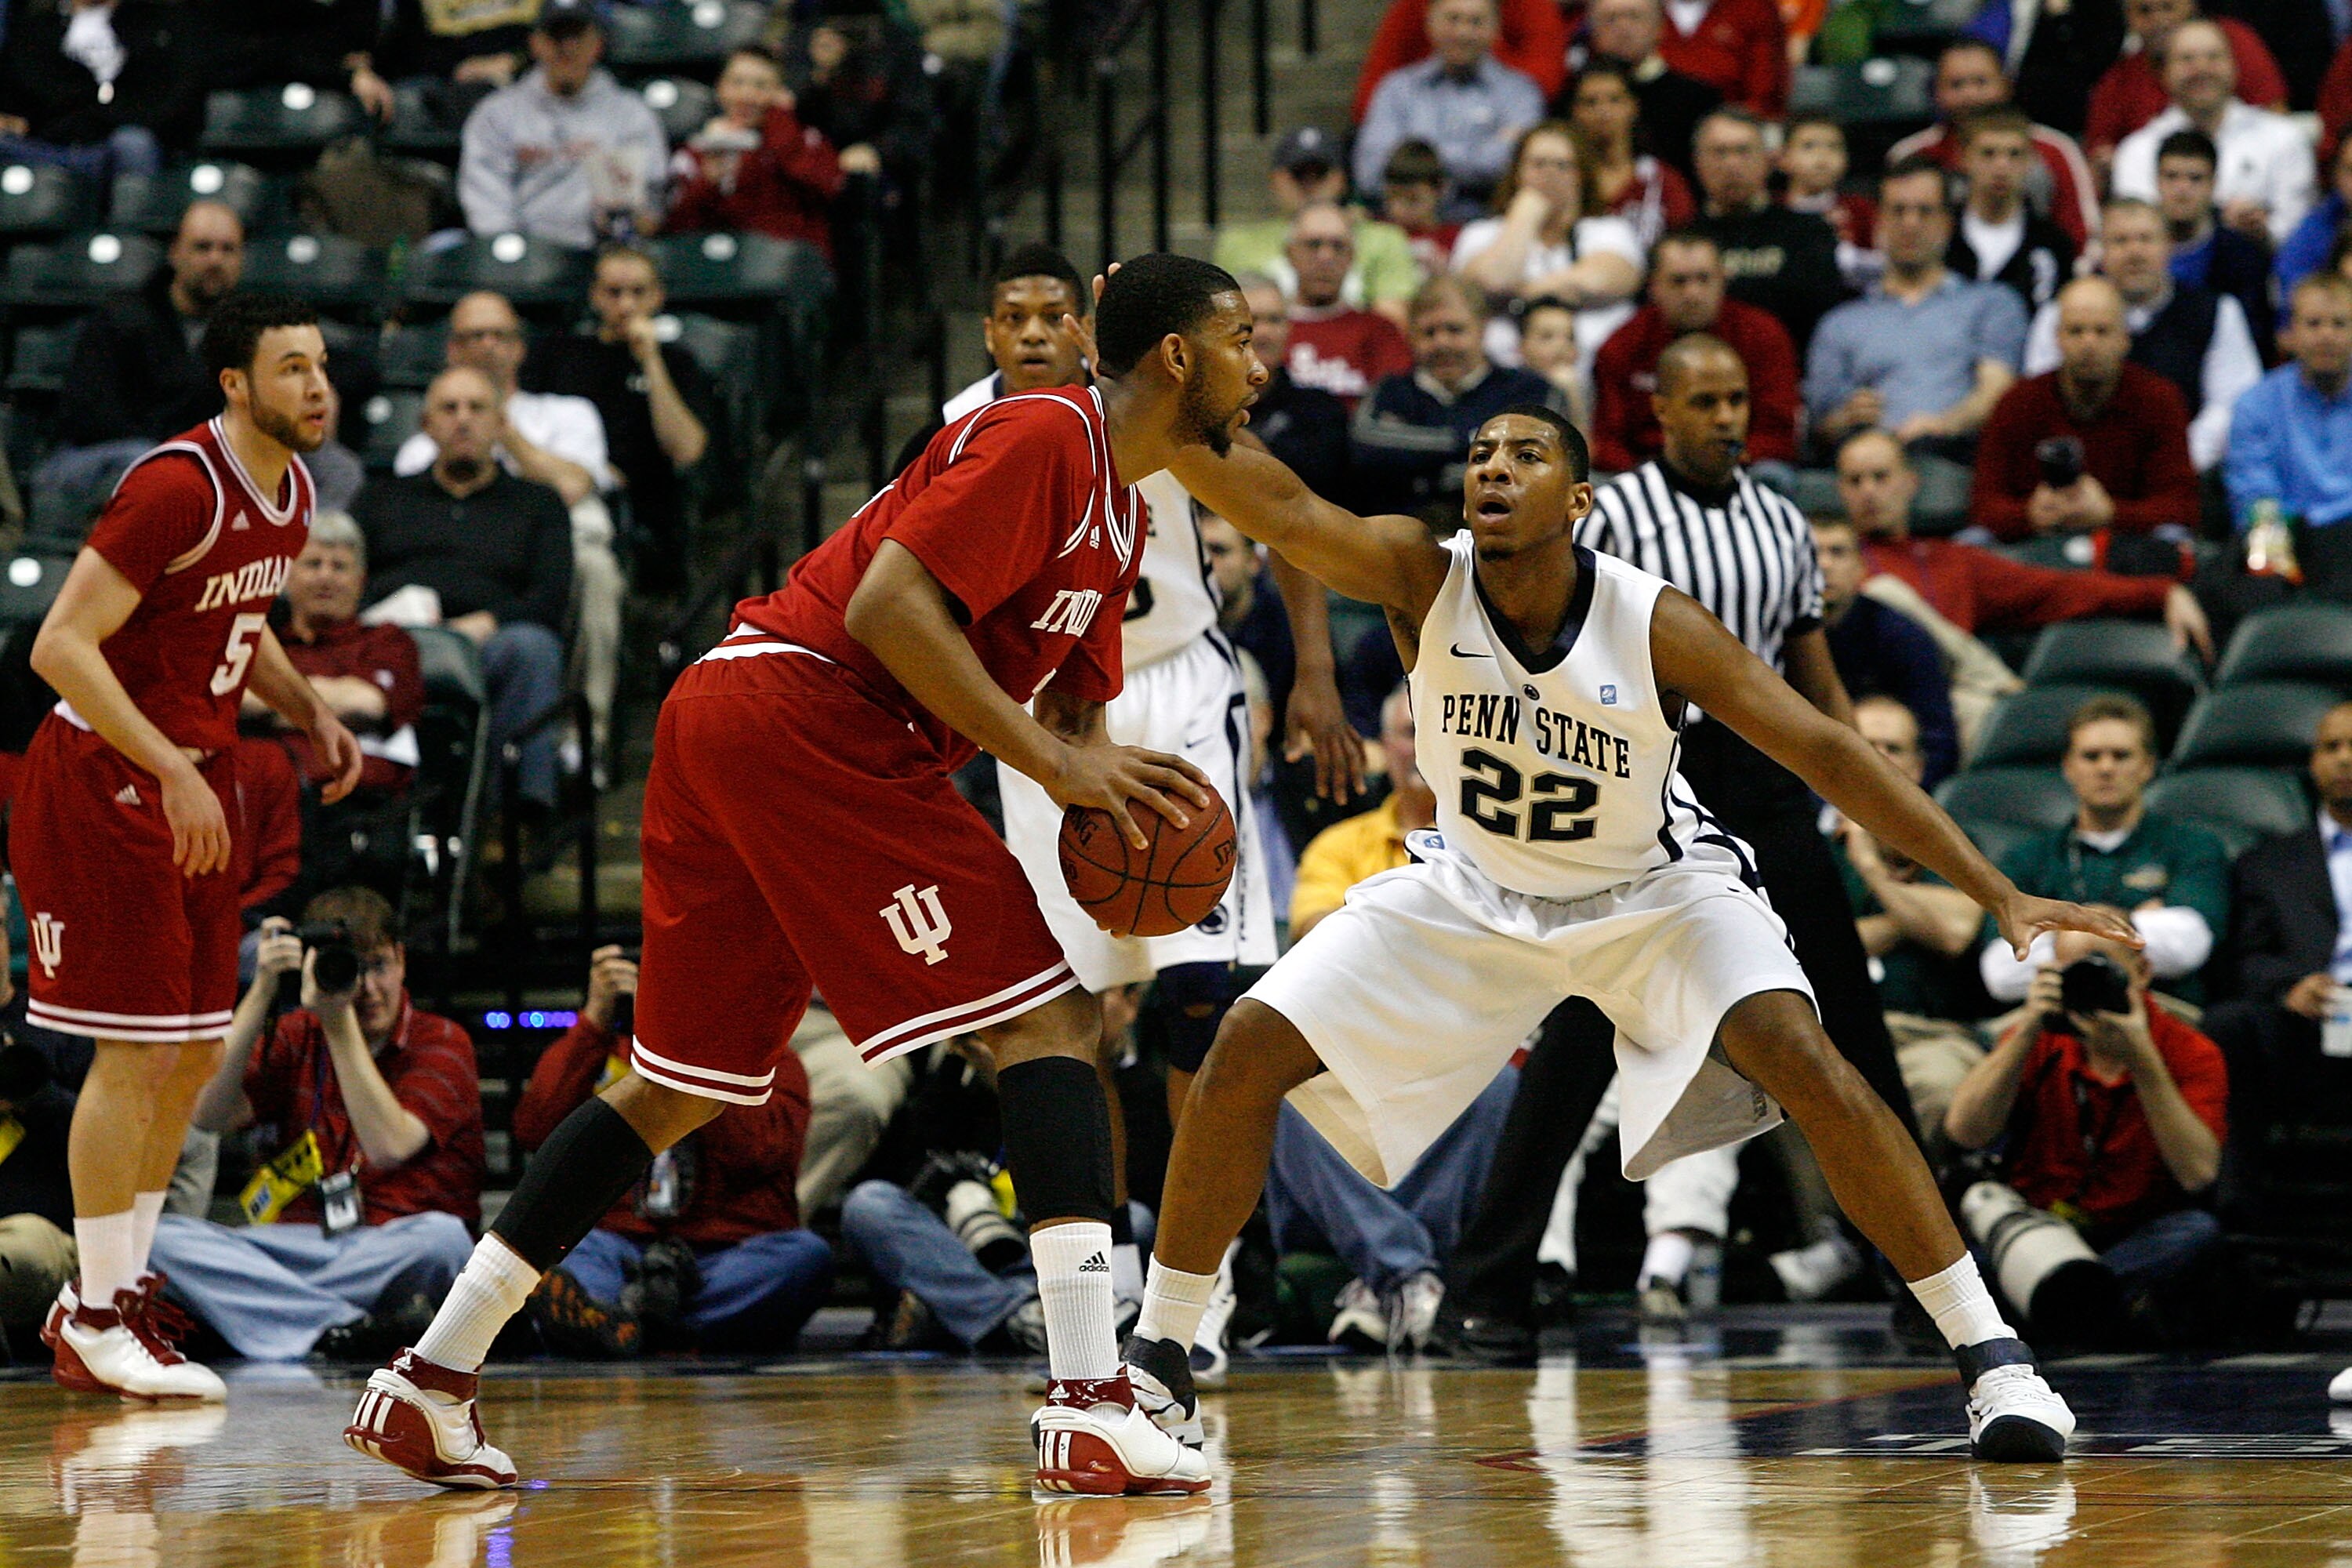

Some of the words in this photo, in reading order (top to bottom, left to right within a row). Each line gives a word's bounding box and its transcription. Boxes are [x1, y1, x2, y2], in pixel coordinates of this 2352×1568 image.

[210, 612, 267, 696] 5
[1442, 694, 1520, 745] PENN
[1535, 707, 1631, 779] STATE
[1459, 746, 1602, 844] 22
